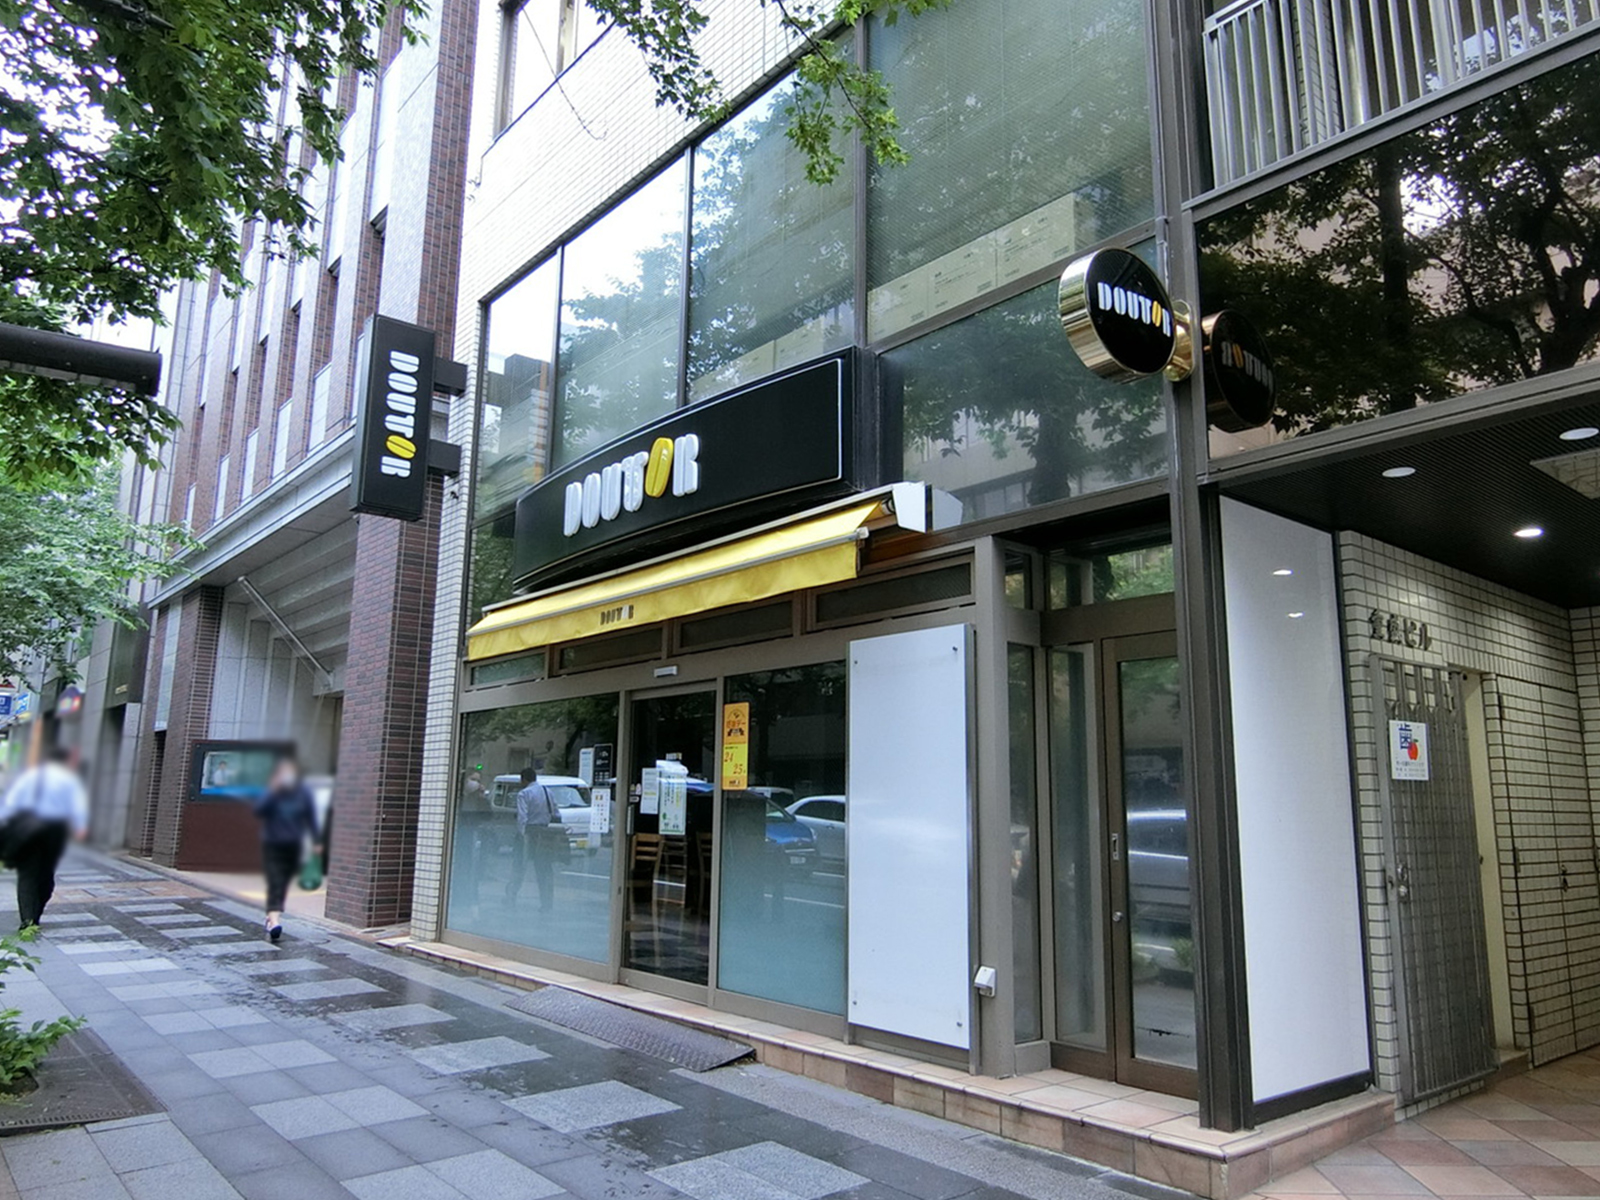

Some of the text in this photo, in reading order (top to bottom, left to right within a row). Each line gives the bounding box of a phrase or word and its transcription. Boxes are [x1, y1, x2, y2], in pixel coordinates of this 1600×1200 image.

[1097, 281, 1172, 338] DOUTOR
[379, 350, 421, 479] DOUTOR
[563, 433, 699, 537] DOUTOR
